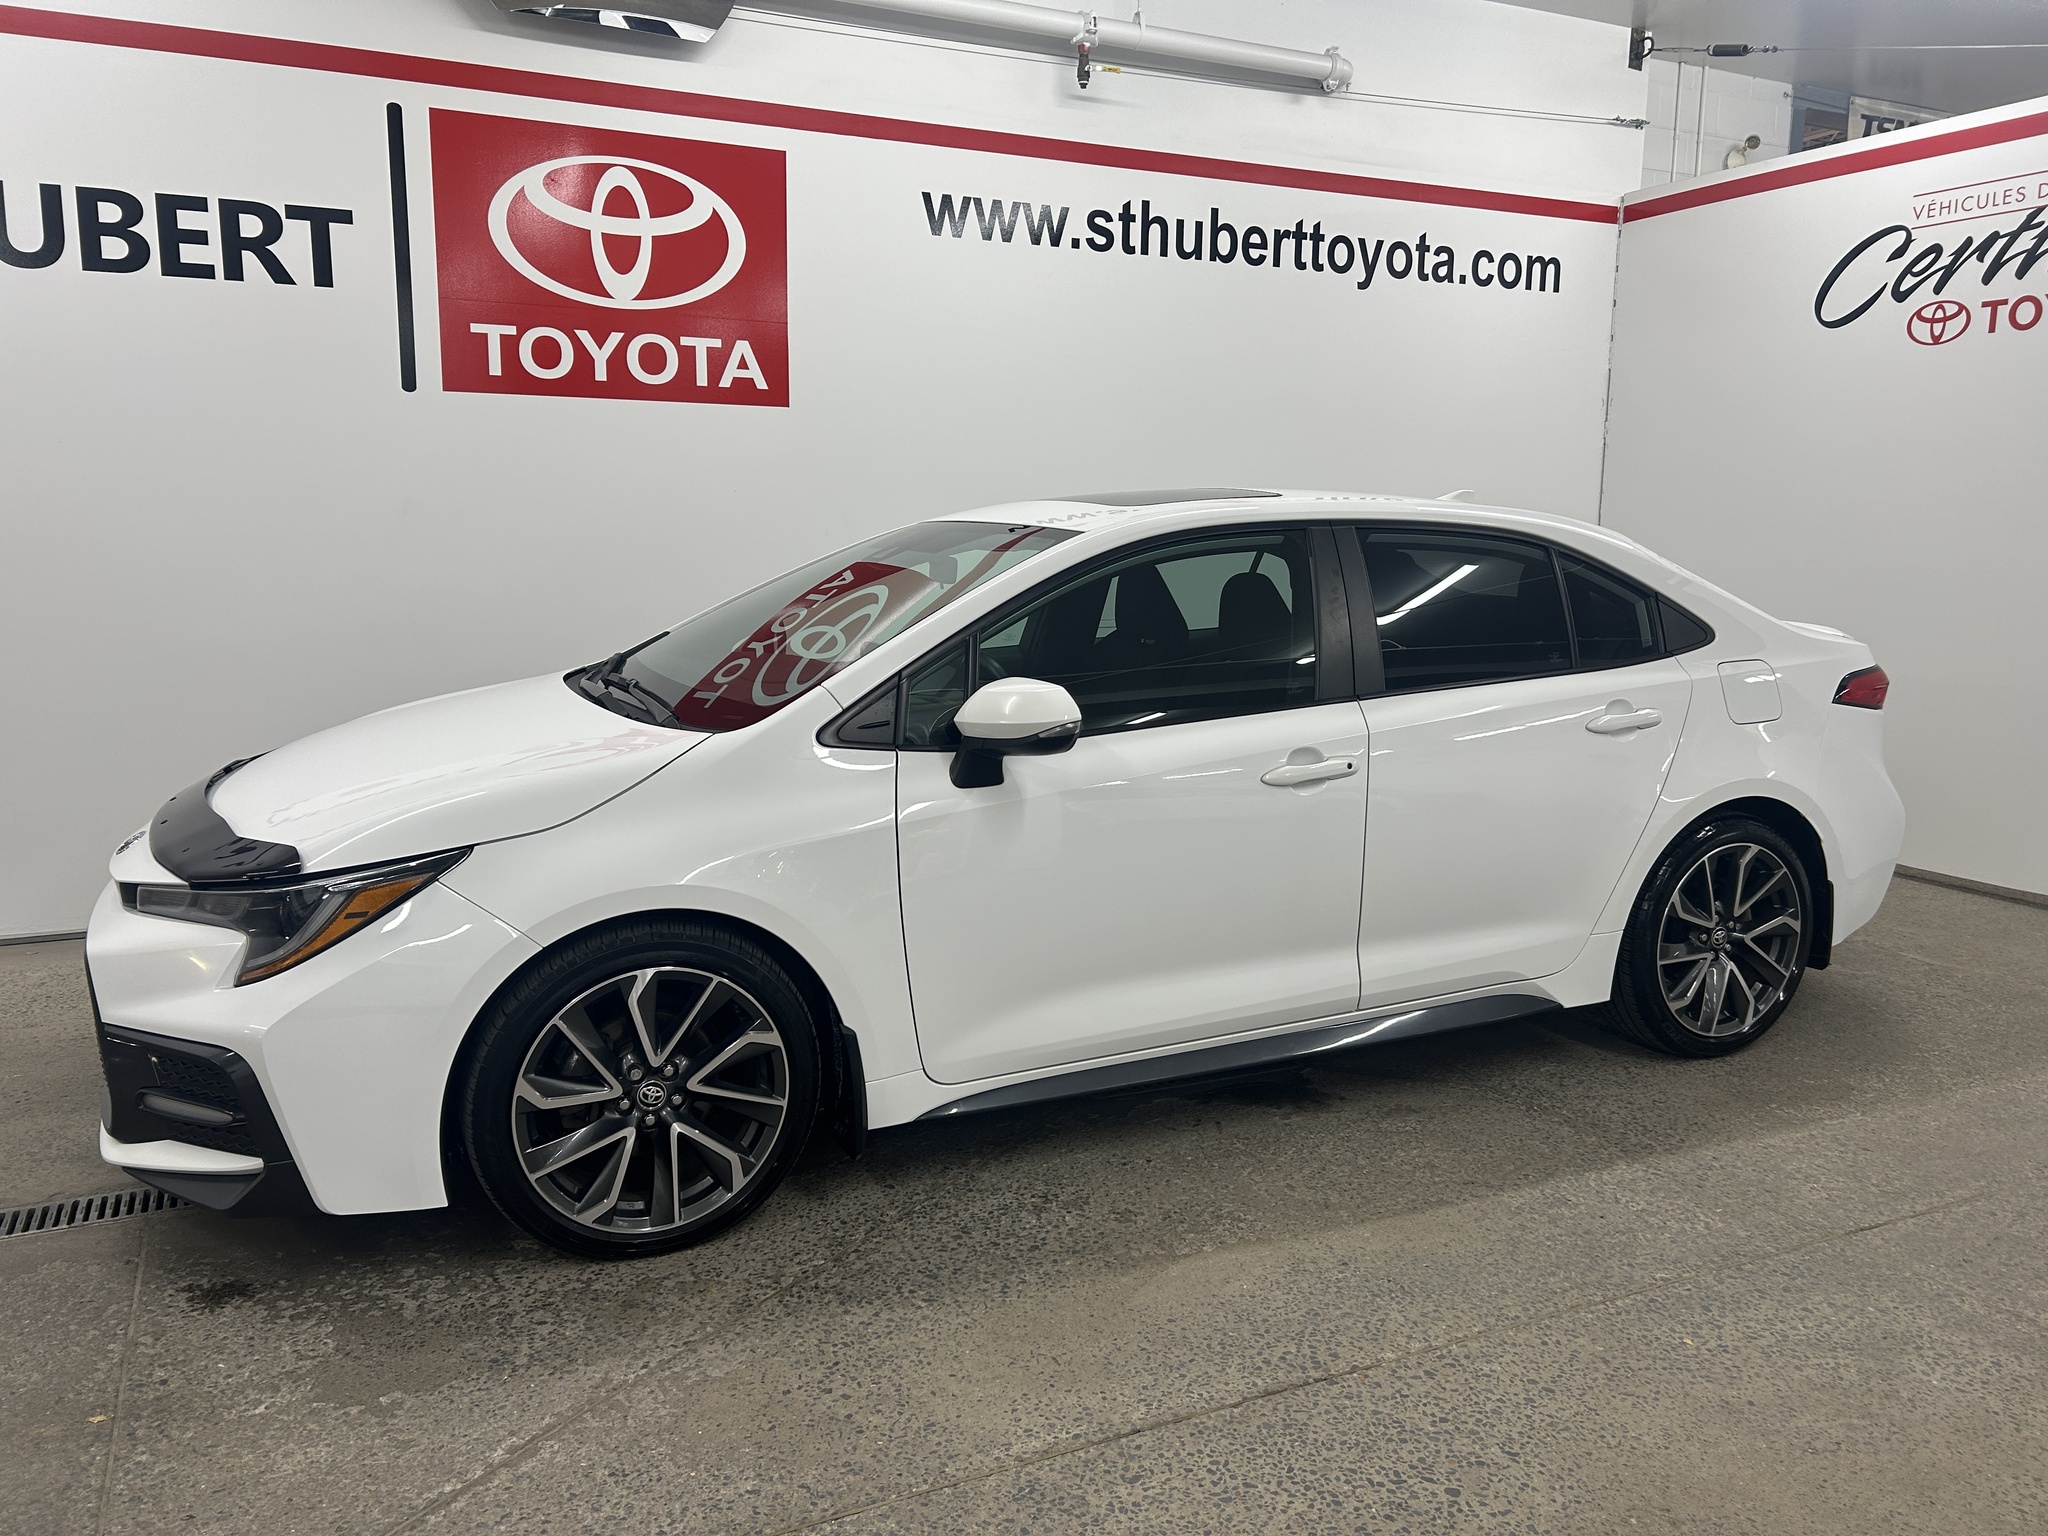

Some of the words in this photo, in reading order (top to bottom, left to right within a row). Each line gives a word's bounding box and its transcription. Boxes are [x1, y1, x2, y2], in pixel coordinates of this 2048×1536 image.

[1912, 186, 2027, 221] VÉHICULES
[921, 190, 1562, 293] www.sthuberttoyota.com
[1981, 293, 2048, 333] TO
[470, 323, 769, 389] TOYOTA
